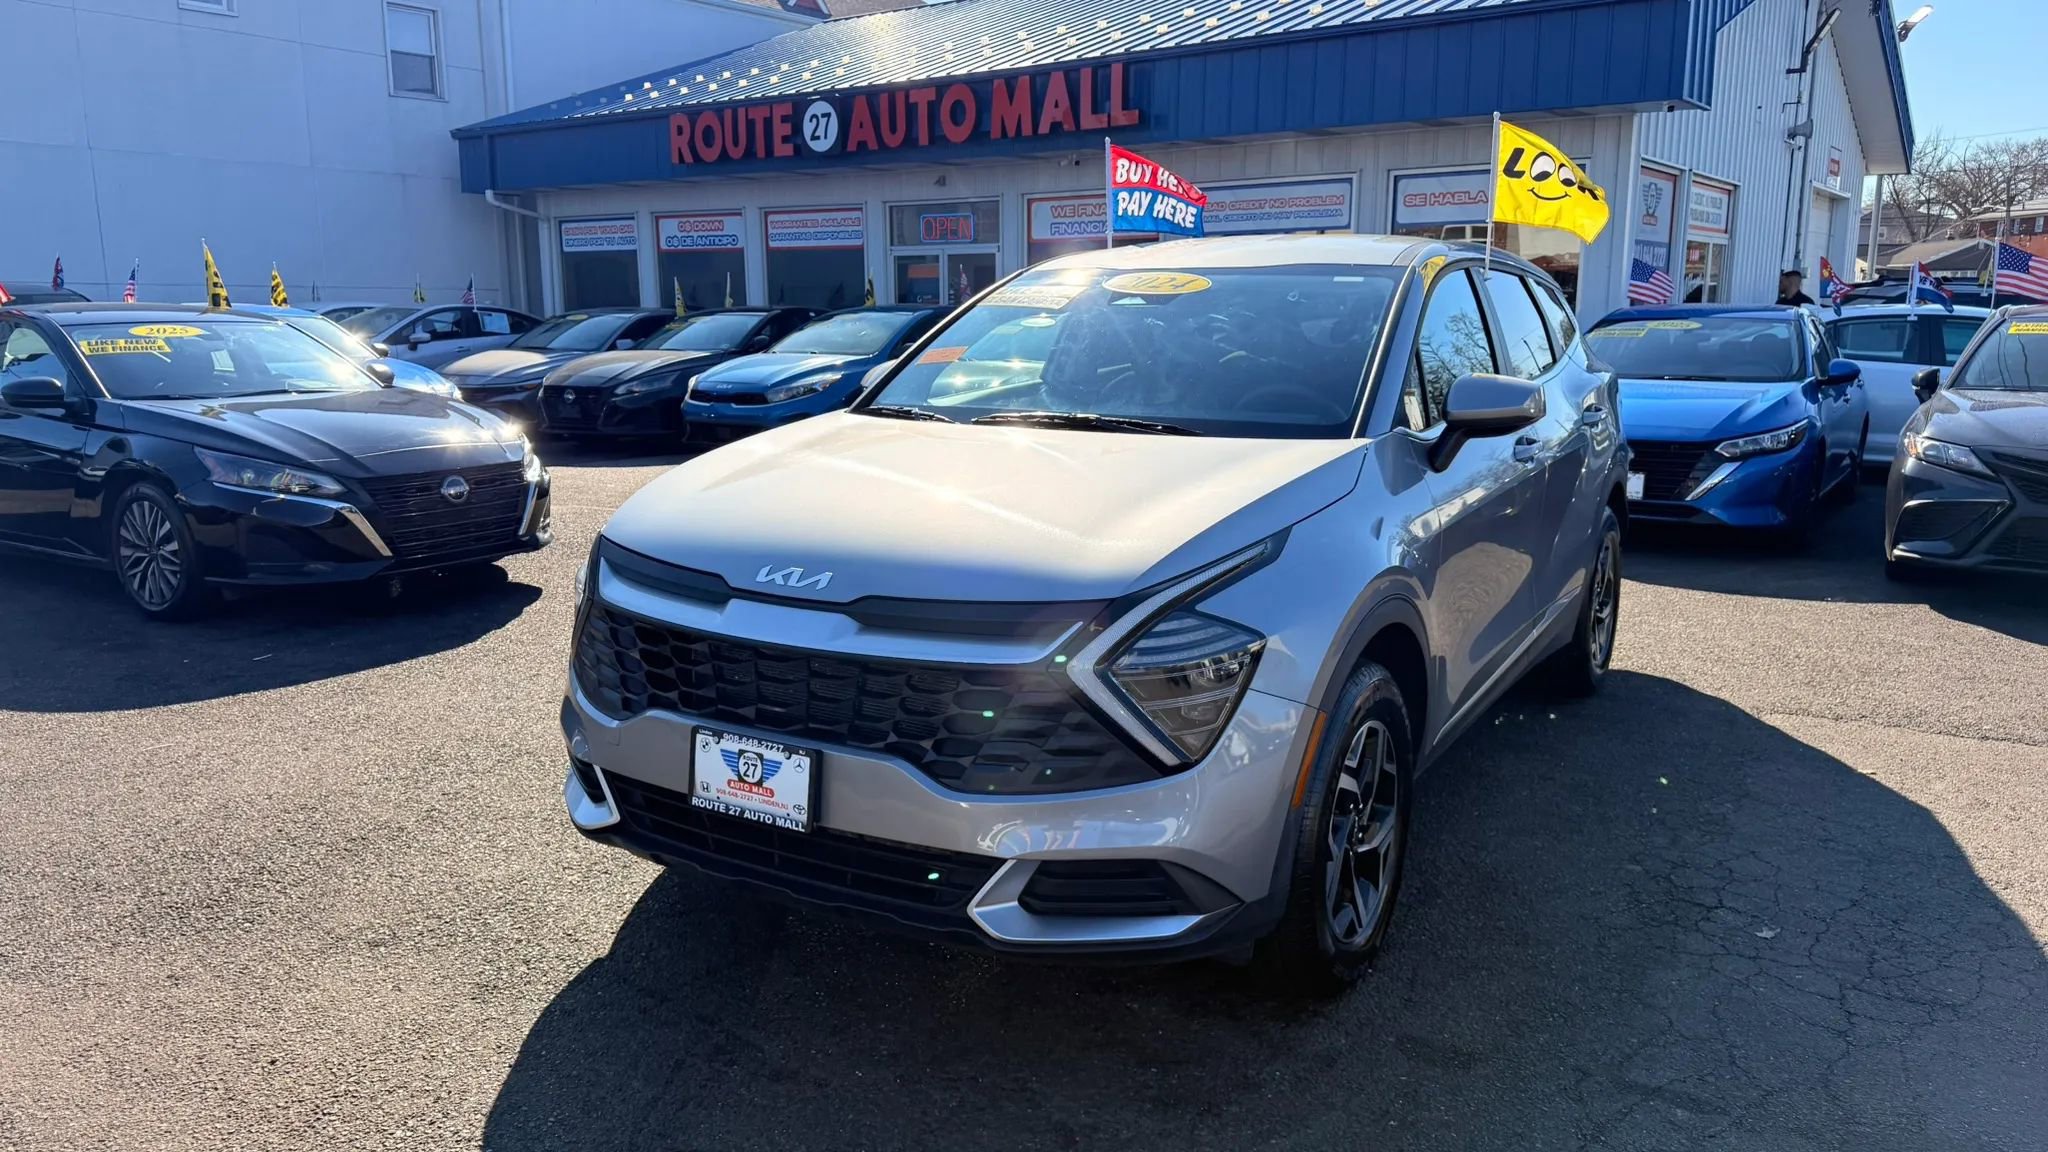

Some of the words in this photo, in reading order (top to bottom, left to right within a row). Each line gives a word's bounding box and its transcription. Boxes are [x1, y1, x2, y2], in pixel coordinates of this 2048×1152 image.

[670, 101, 794, 165] ROUTE
[808, 112, 832, 141] 27
[847, 83, 977, 152] AUTO
[991, 63, 1139, 139] MALL
[1115, 158, 1153, 184] BUY
[1157, 166, 1190, 199] HE
[1204, 201, 1227, 212] BAD
[1228, 199, 1268, 211] CREDIT
[1269, 197, 1287, 209] NO
[1288, 195, 1344, 208] PROBLEM
[1404, 192, 1427, 208] SE
[1428, 190, 1488, 207] HABLA
[1050, 204, 1076, 218] WE
[1077, 203, 1107, 217] FINA
[1117, 191, 1152, 217] PAY
[1153, 193, 1198, 229] HERE
[1204, 214, 1222, 223] MAL
[1223, 213, 1259, 222] CREDITO
[1260, 211, 1273, 220] NO
[1293, 208, 1343, 219] PROBLEMA
[583, 226, 599, 235] FOR
[599, 225, 618, 234] YOUR
[619, 224, 635, 233] CAR
[693, 219, 724, 232] DOWN
[923, 217, 972, 240] OPEN
[1050, 220, 1108, 236] FINANCI
[565, 238, 589, 247] DINERO
[589, 237, 604, 246] POR
[605, 236, 616, 246] TU
[617, 235, 637, 245] AUTO
[680, 236, 694, 247] DE
[695, 234, 738, 247] ANTICIPO
[769, 231, 812, 241] GARANTIAS
[812, 230, 863, 240] DISPONIBLES
[145, 327, 189, 335] 2025
[87, 339, 119, 347] LIKE
[124, 338, 158, 346] NEW
[756, 564, 833, 591] KIA
[722, 733, 784, 753] 908-648-2727
[742, 754, 758, 763] ROUTE
[743, 761, 758, 779] 27
[730, 781, 750, 791] AUTO
[751, 785, 772, 797] MALL
[692, 797, 727, 813] ROUTE
[728, 805, 741, 816] 27
[744, 810, 772, 824] AUTO
[776, 817, 805, 832] MALL
